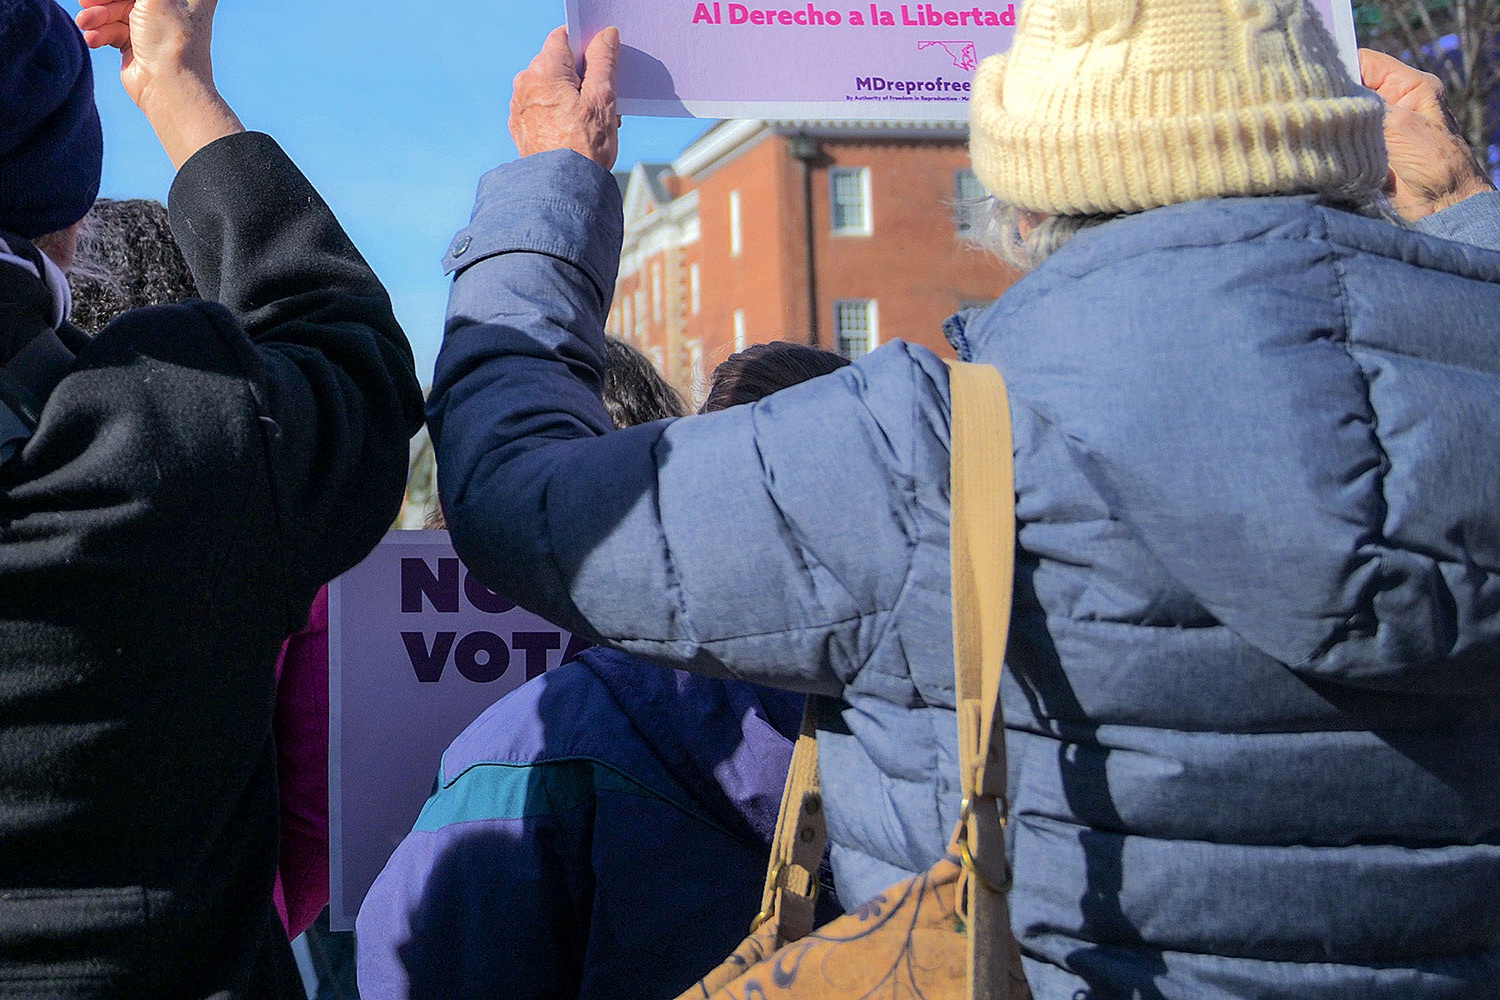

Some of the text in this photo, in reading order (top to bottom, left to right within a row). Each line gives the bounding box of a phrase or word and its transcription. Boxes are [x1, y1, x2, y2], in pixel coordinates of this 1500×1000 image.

[691, 1, 1016, 27] Al Derecho a la Libertad
[855, 77, 971, 95] MDreprofree
